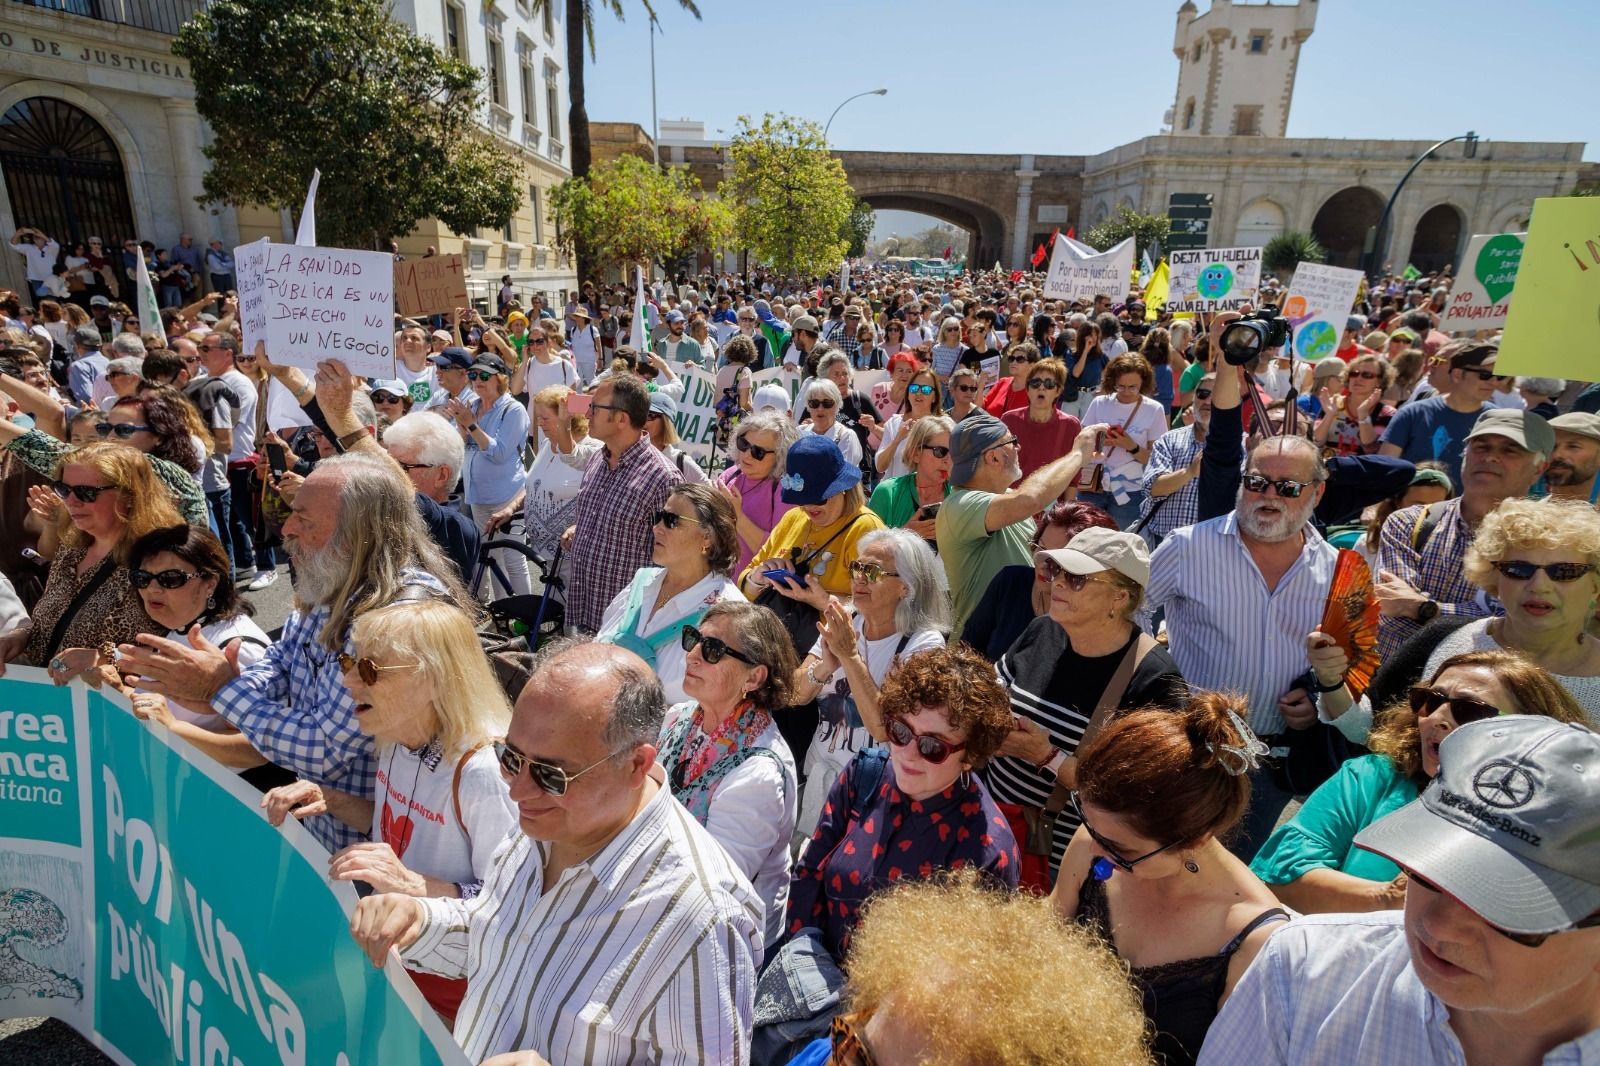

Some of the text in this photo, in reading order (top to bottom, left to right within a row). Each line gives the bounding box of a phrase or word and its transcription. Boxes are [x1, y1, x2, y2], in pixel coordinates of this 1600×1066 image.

[32, 38, 61, 56] DE
[80, 48, 184, 79] JUSTICIA
[264, 248, 291, 273] LA
[1173, 248, 1260, 264] DEJA TU HUELLA
[1058, 261, 1073, 277] Por
[1074, 268, 1088, 278] una
[1090, 265, 1119, 283] justicia
[344, 288, 361, 302] ES
[370, 292, 389, 303] UN
[1051, 280, 1073, 293] social
[1073, 285, 1079, 298] y
[1454, 291, 1473, 304] NO
[272, 303, 383, 328] DERECHO NO
[1195, 301, 1205, 312] EL
[289, 331, 389, 357] UN NEGOCIO
[1439, 789, 1542, 847] Mercedes-Benz
[184, 878, 306, 1066] una
